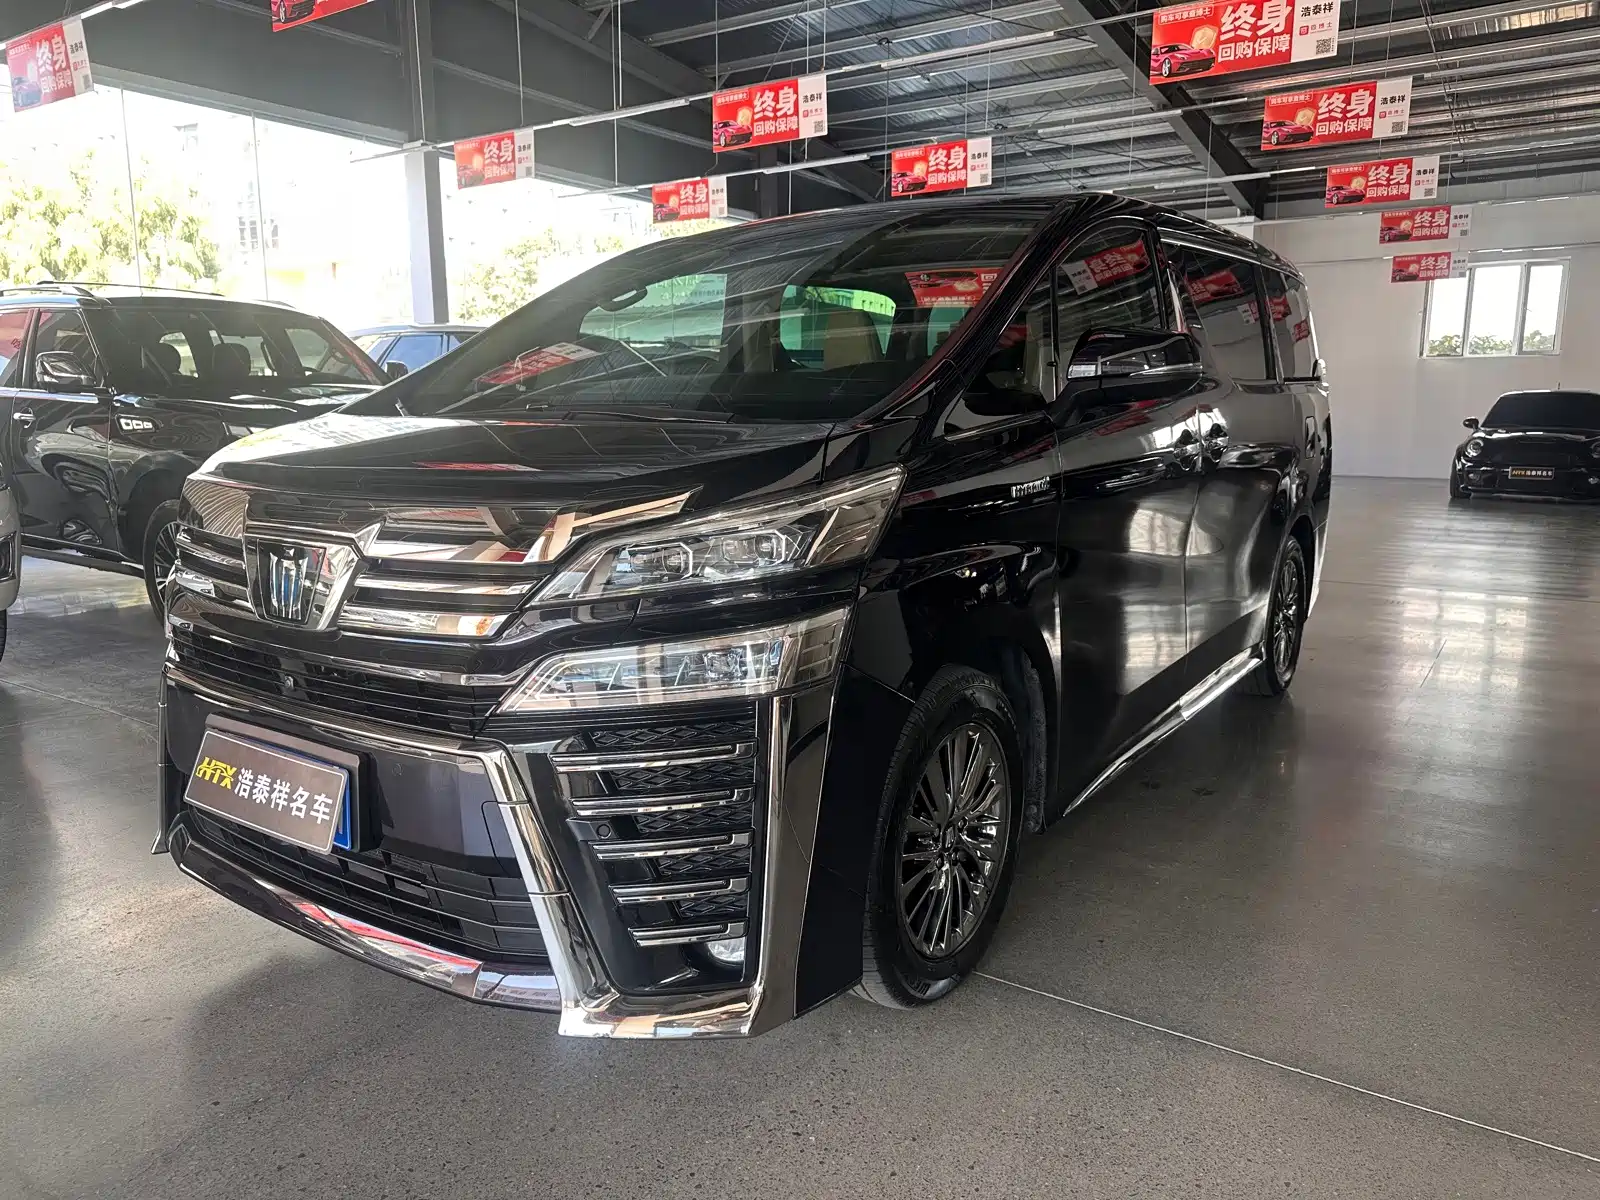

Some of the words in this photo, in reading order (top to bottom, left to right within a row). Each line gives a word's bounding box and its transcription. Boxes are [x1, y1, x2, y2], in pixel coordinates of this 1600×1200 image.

[1220, 0, 1294, 41] 终身
[1300, 2, 1334, 18] 浩泰祥
[36, 34, 67, 75] 终身
[1217, 33, 1292, 63] 回购保障
[753, 86, 797, 119] 终身
[1317, 89, 1375, 120] 终身
[753, 115, 798, 136] 回购保障
[1315, 117, 1372, 136] 回购保障
[484, 137, 514, 164] 终身
[928, 146, 966, 171] 终身
[928, 169, 966, 185] 回购保障
[1368, 163, 1411, 185] 终身
[680, 182, 707, 204] 终身
[1366, 185, 1409, 198] 回购保障
[1414, 210, 1449, 227] 终身
[1412, 226, 1448, 237] 回购保障
[1420, 255, 1449, 270] 终身
[234, 767, 332, 824] 浩泰祥名车
